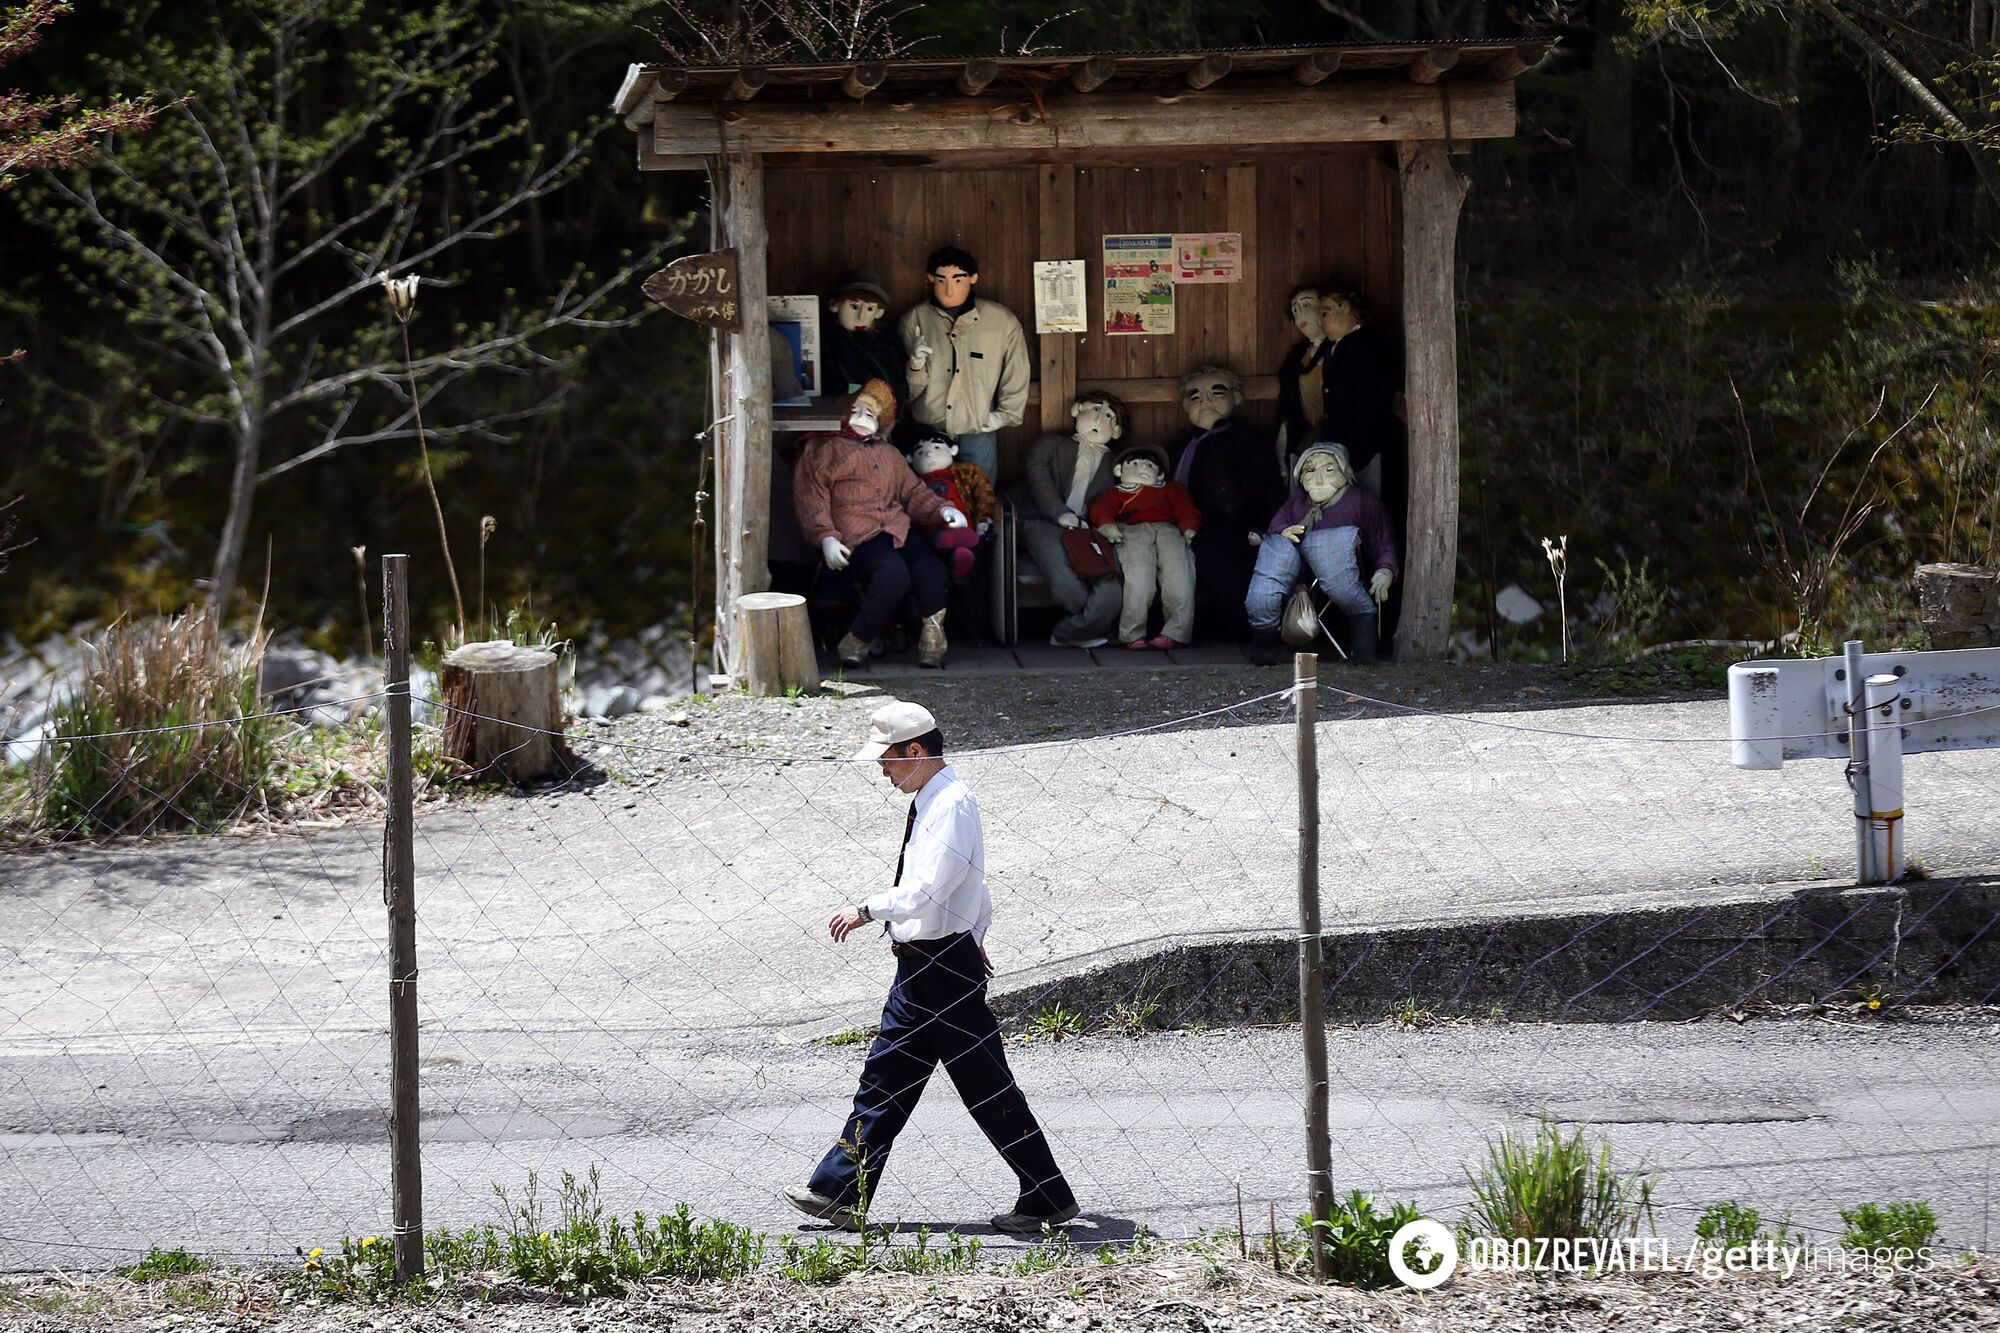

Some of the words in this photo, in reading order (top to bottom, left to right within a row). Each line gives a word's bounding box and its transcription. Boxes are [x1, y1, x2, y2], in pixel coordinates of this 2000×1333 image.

[668, 268, 731, 295] かかし
[690, 301, 735, 320] バス停
